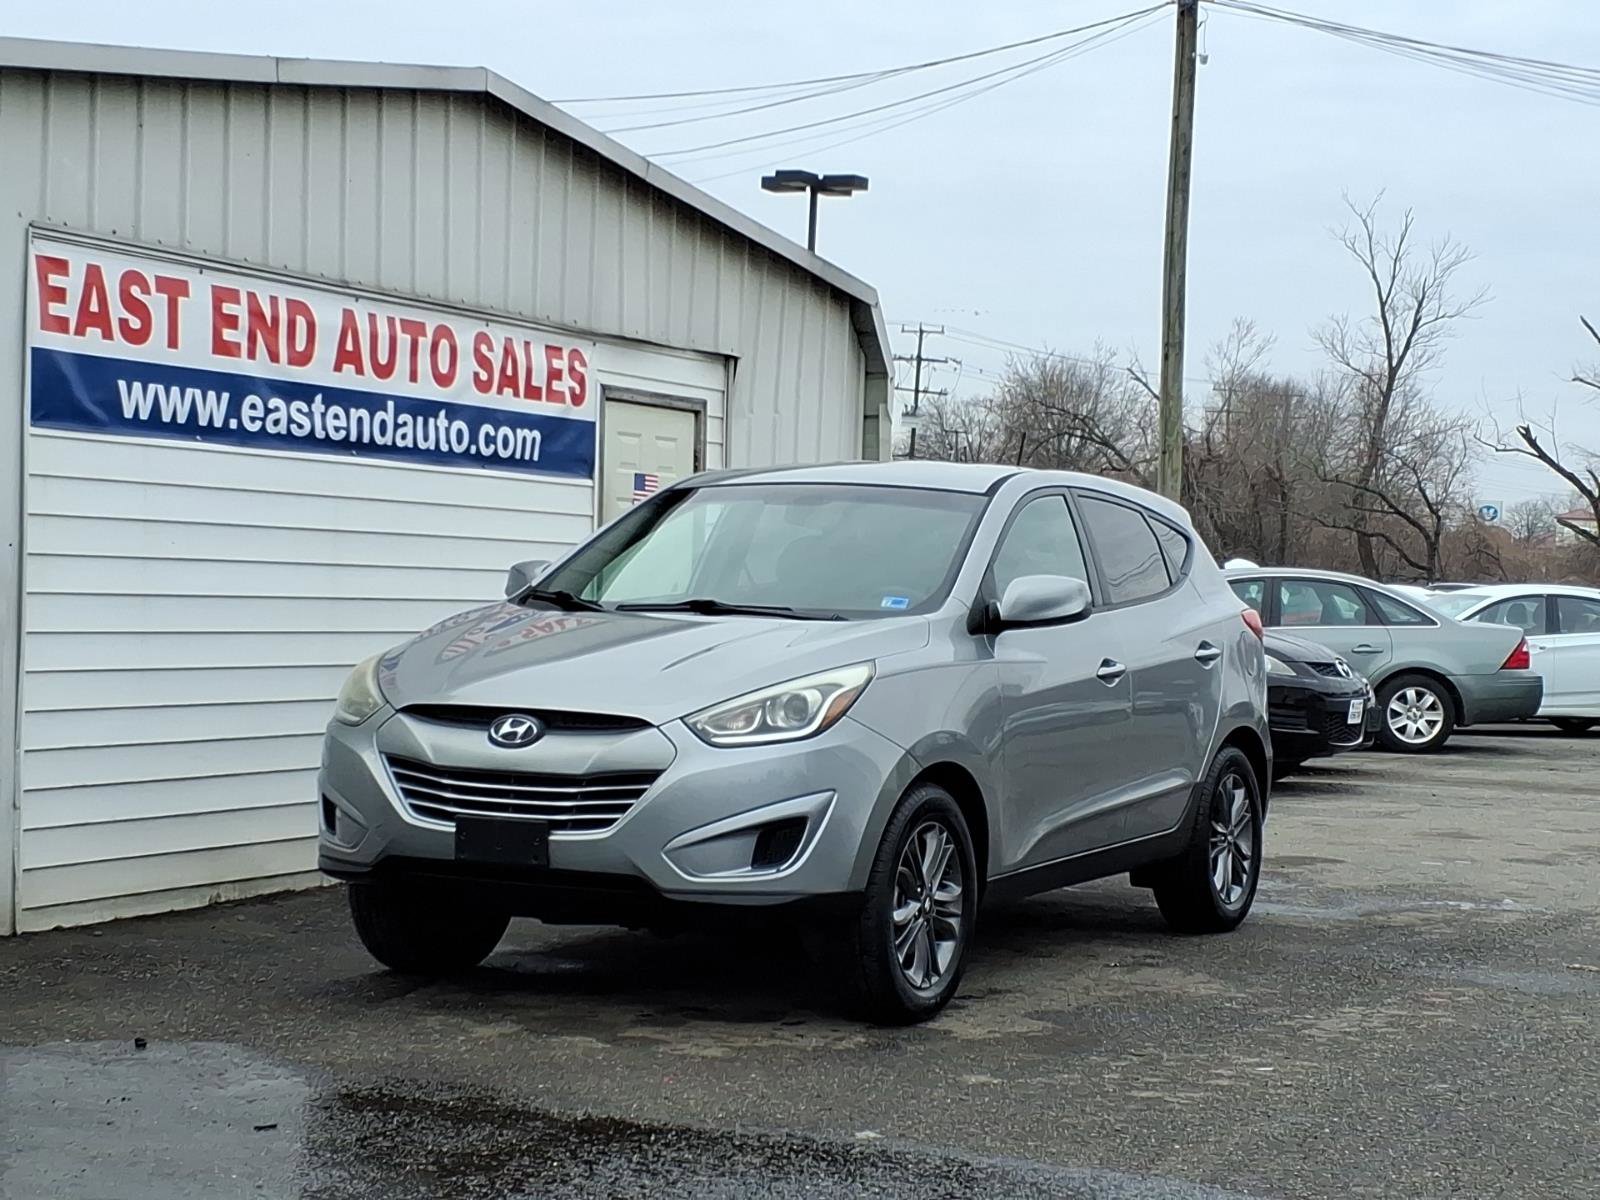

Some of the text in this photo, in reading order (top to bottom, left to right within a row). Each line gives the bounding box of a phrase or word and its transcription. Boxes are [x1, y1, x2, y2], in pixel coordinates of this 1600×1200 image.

[35, 254, 588, 407] EAST END AUTO SALES
[117, 380, 542, 462] www.eastendauto.com
